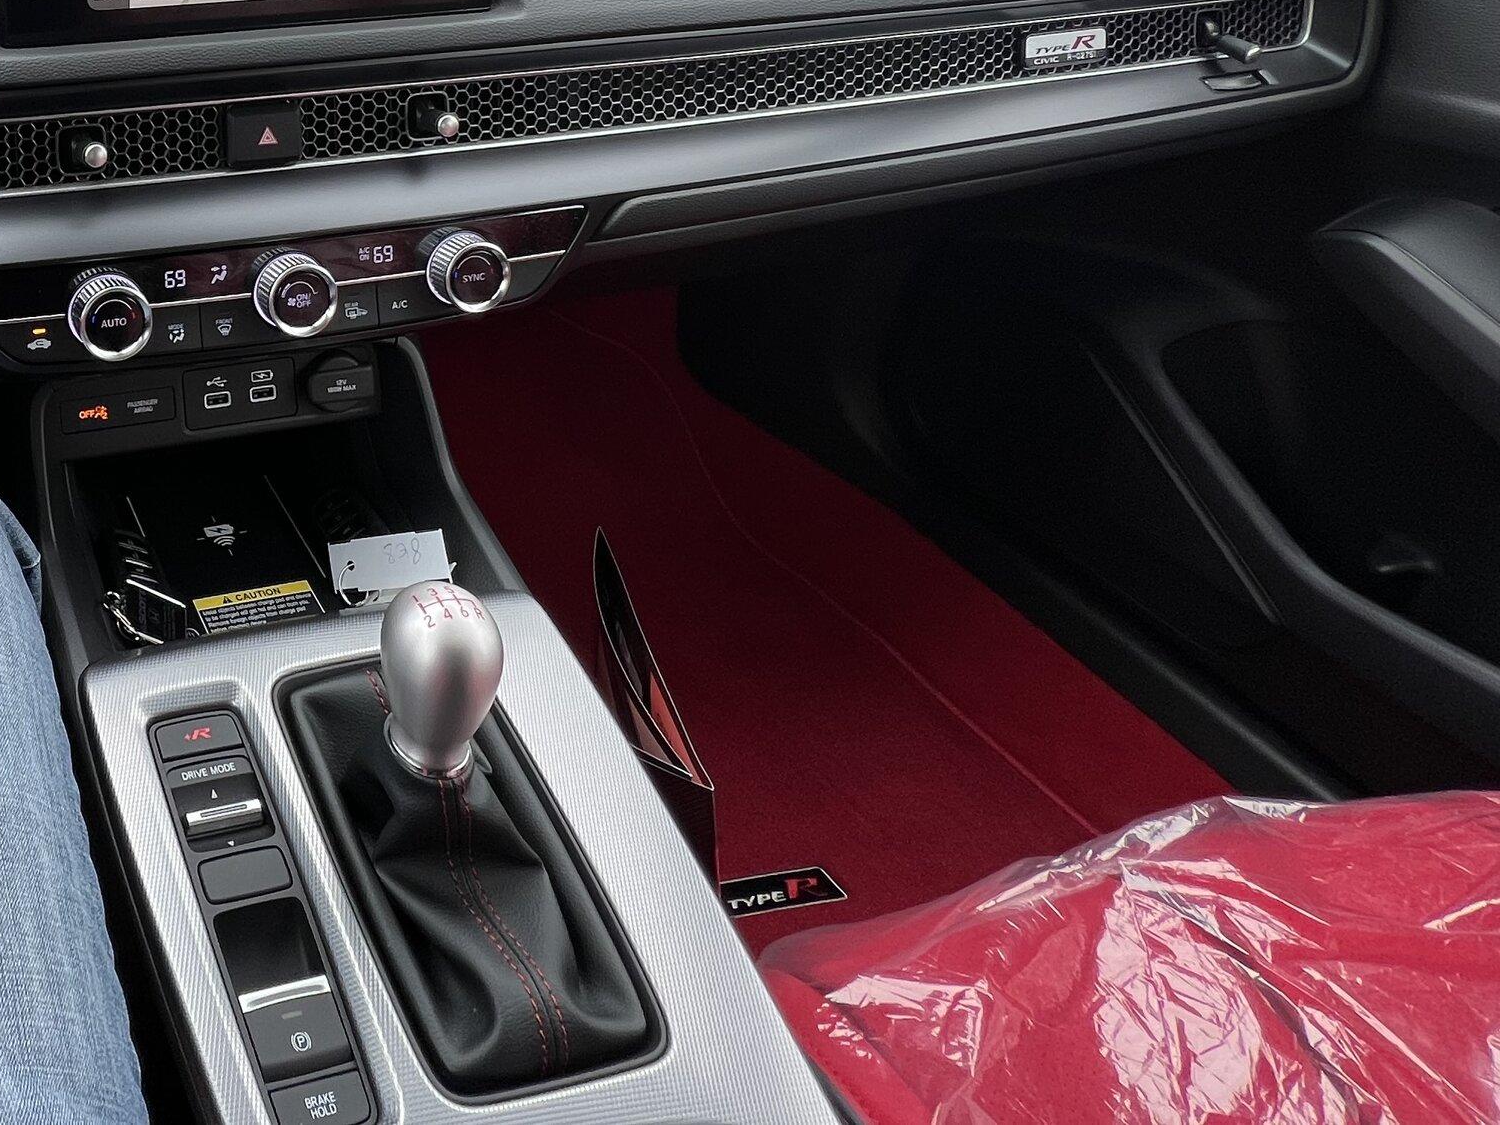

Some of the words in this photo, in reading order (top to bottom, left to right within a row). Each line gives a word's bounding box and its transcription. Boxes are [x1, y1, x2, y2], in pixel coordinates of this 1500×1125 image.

[1035, 45, 1072, 55] TYPE
[1070, 34, 1096, 50] R
[1033, 56, 1060, 65] CIVIC
[373, 245, 394, 264] 69
[164, 269, 187, 289] 69
[462, 272, 486, 282] SYNC
[296, 299, 312, 308] OFF
[391, 300, 408, 310] A/C
[100, 317, 128, 329] AUTO
[79, 409, 95, 419] OFF
[235, 587, 282, 602] CAUTION
[427, 587, 438, 597] 3
[423, 615, 436, 628] 2
[444, 608, 453, 620] 4
[460, 609, 469, 618] 6
[474, 607, 485, 621] R
[181, 767, 209, 781] DRIVE
[209, 762, 236, 775] MODE
[727, 891, 787, 909] TYPE
[304, 1091, 337, 1109] BRAKE
[310, 1103, 338, 1120] HOLD
